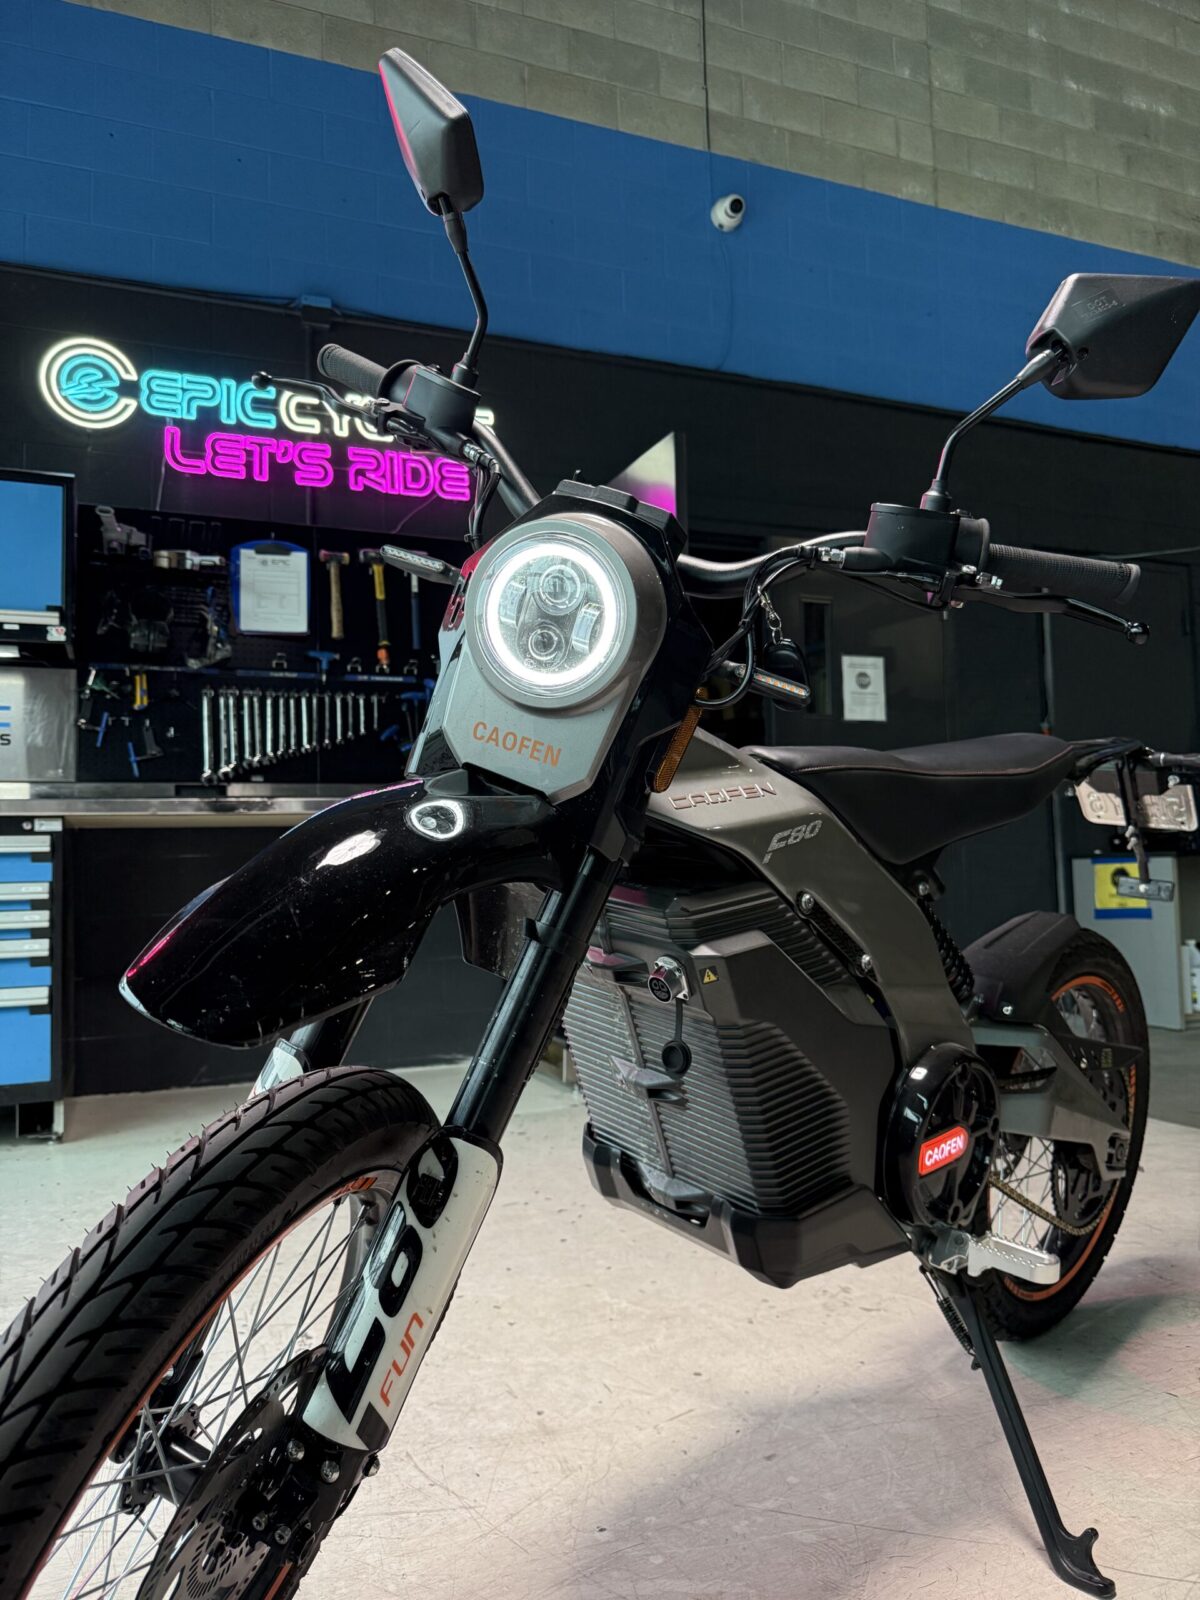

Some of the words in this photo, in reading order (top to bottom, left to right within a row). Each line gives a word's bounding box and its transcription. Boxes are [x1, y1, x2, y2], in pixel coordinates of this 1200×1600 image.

[140, 369, 277, 429] EPIC
[164, 426, 334, 488] LET'S
[347, 446, 471, 501] RIDE
[472, 720, 562, 768] CAOFEN
[668, 782, 777, 810] CAOFEN
[762, 819, 823, 865] F80
[924, 1134, 965, 1167] CAOFEN
[379, 1312, 425, 1408] FUN
